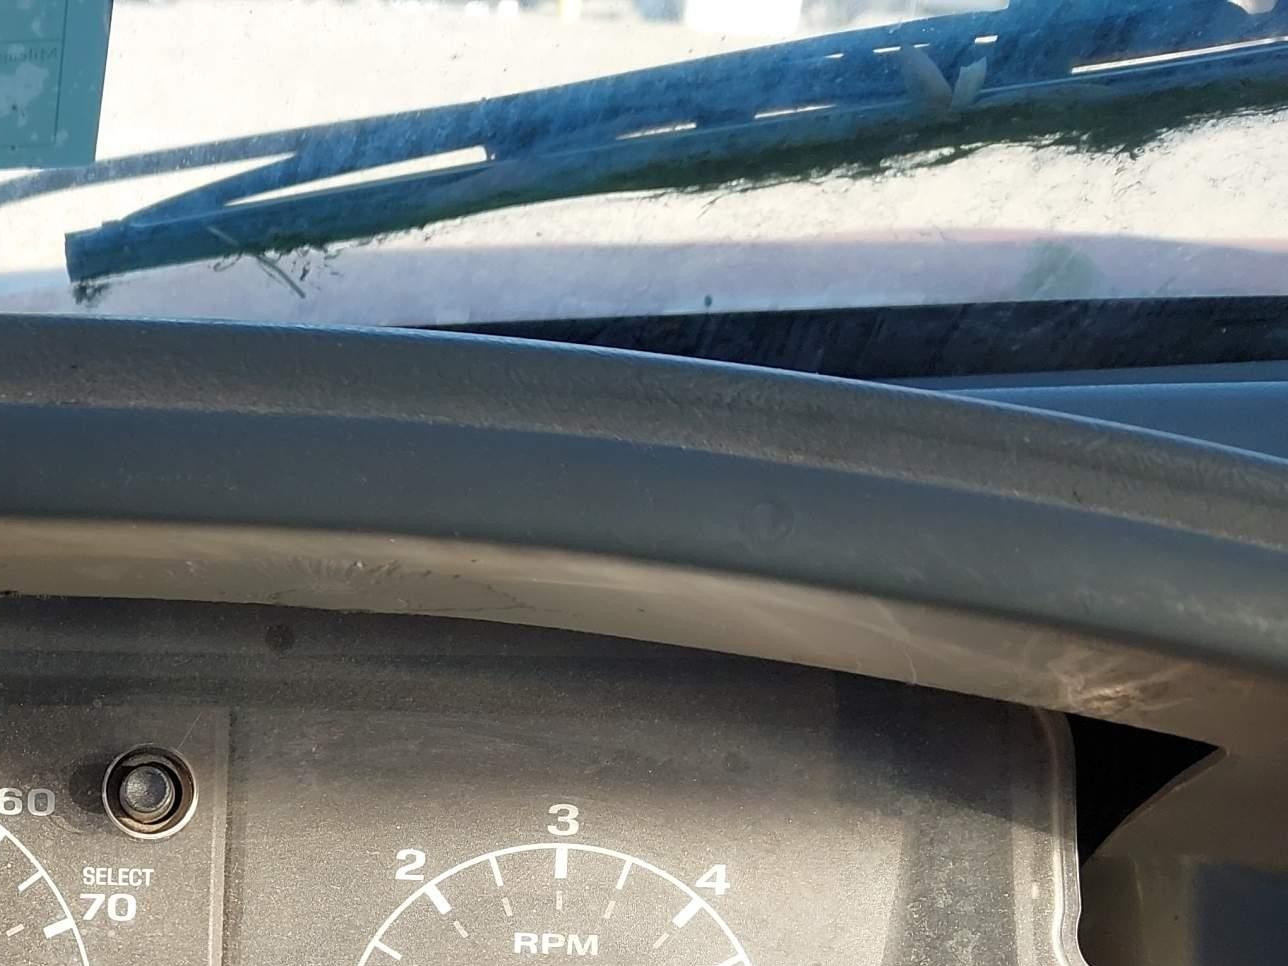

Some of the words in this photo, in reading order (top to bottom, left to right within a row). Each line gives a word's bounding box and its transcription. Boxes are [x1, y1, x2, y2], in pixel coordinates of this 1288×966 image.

[547, 804, 580, 837] 3
[82, 867, 154, 888] SELECT
[395, 849, 426, 882] 2
[696, 864, 731, 895] 4
[81, 893, 138, 922] 70
[514, 934, 599, 955] RPM
